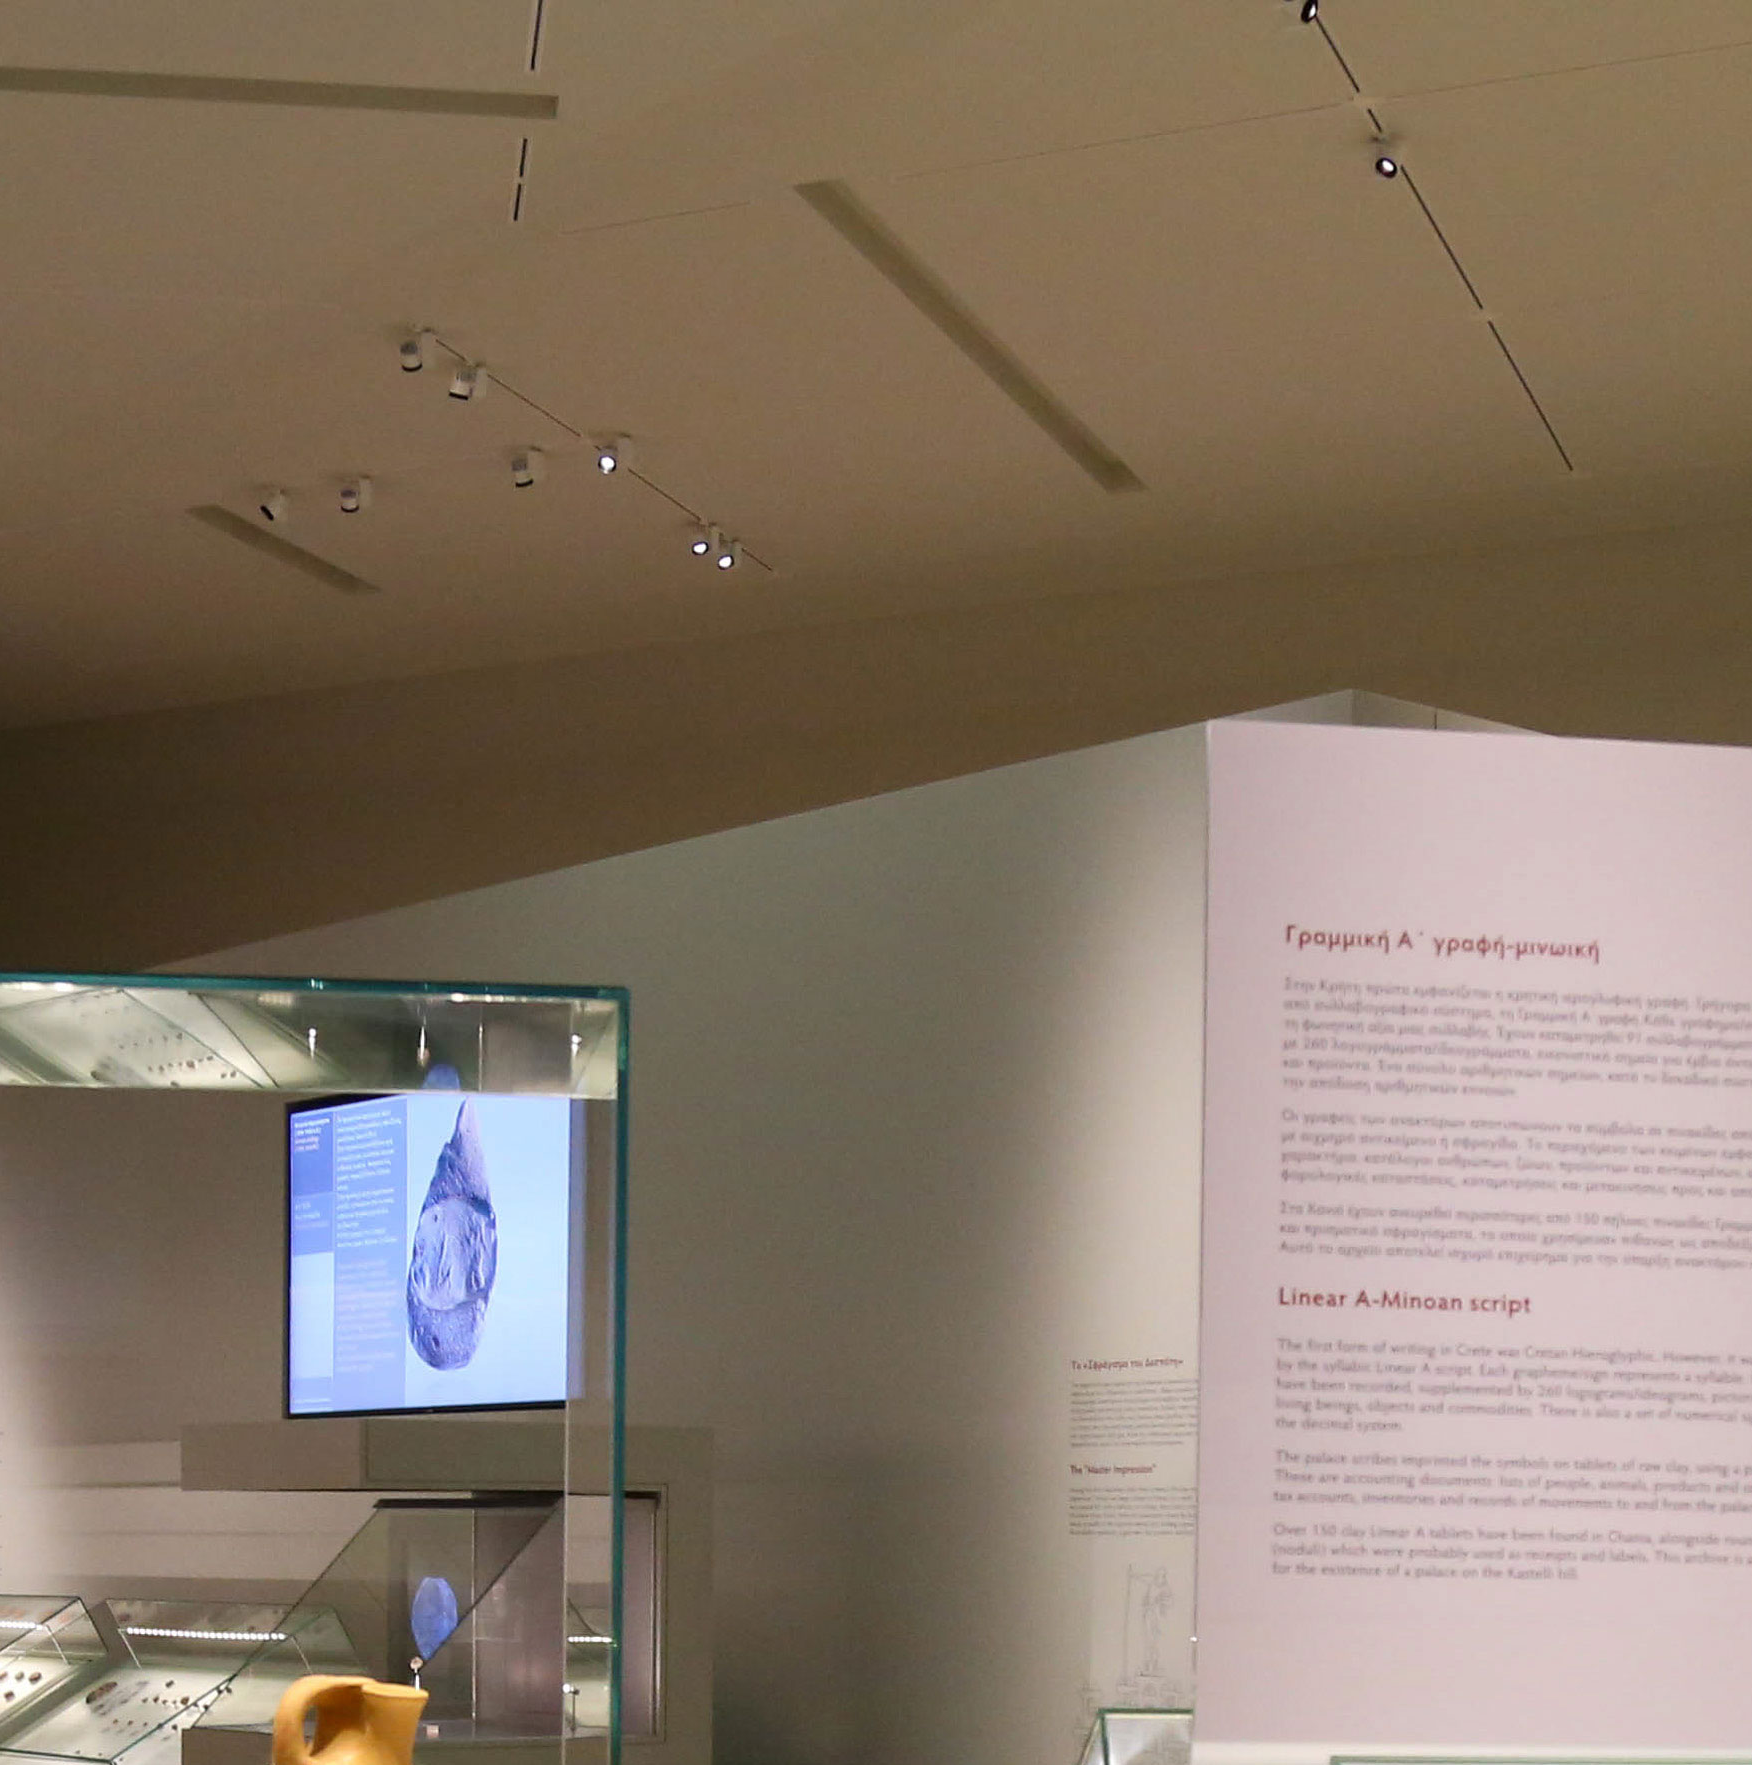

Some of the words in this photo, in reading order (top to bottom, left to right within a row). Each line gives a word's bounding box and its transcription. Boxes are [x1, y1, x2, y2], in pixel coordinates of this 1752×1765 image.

[1285, 926, 1389, 953] Γραμμική
[1433, 934, 1599, 963] γραφή-μινωική
[1277, 1286, 1346, 1308] Linear
[1354, 1288, 1462, 1311] A-Minoan
[1469, 1292, 1530, 1319] script
